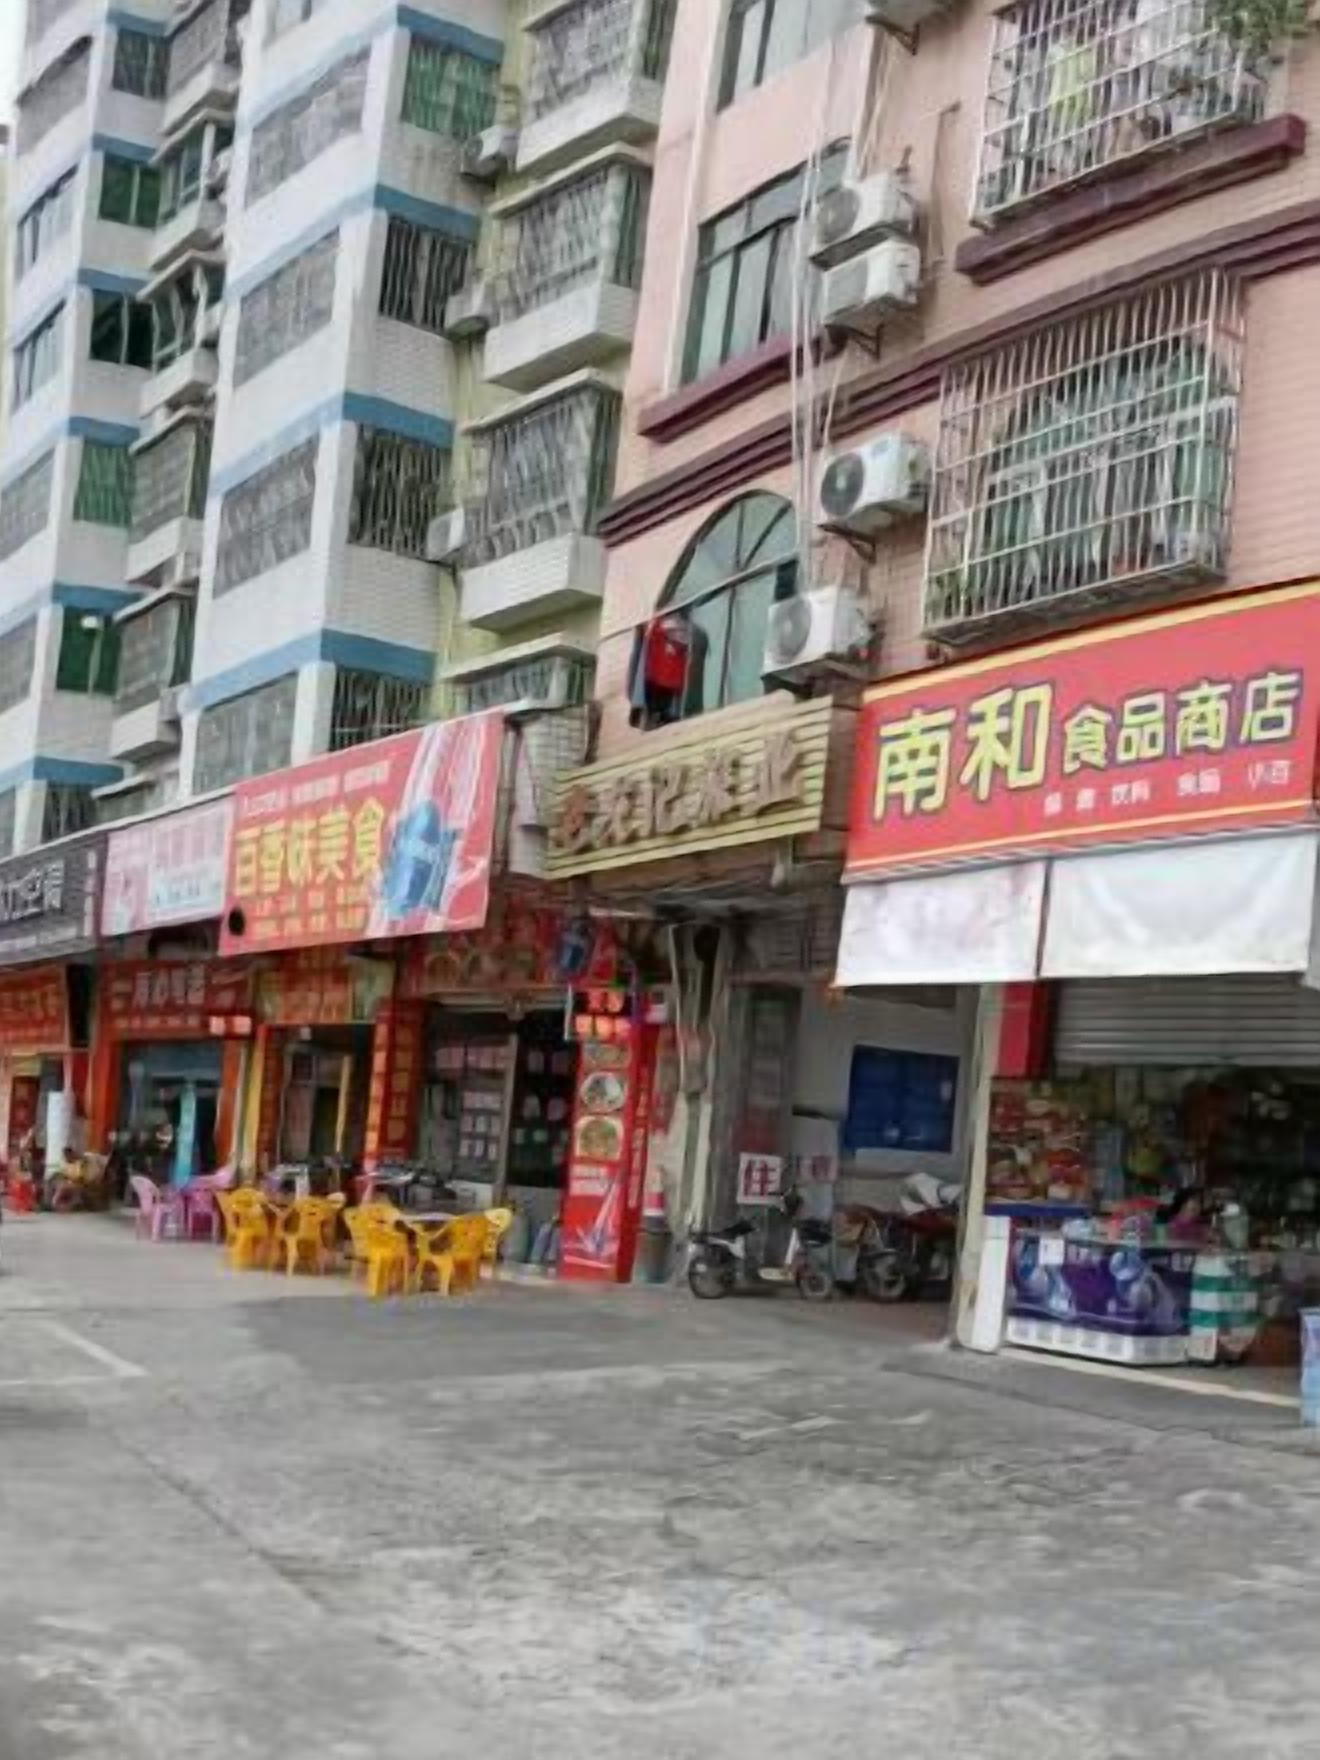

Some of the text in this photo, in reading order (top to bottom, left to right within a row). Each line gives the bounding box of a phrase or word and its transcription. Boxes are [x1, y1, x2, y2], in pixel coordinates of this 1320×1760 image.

[873, 670, 1302, 821] 南和食品商店
